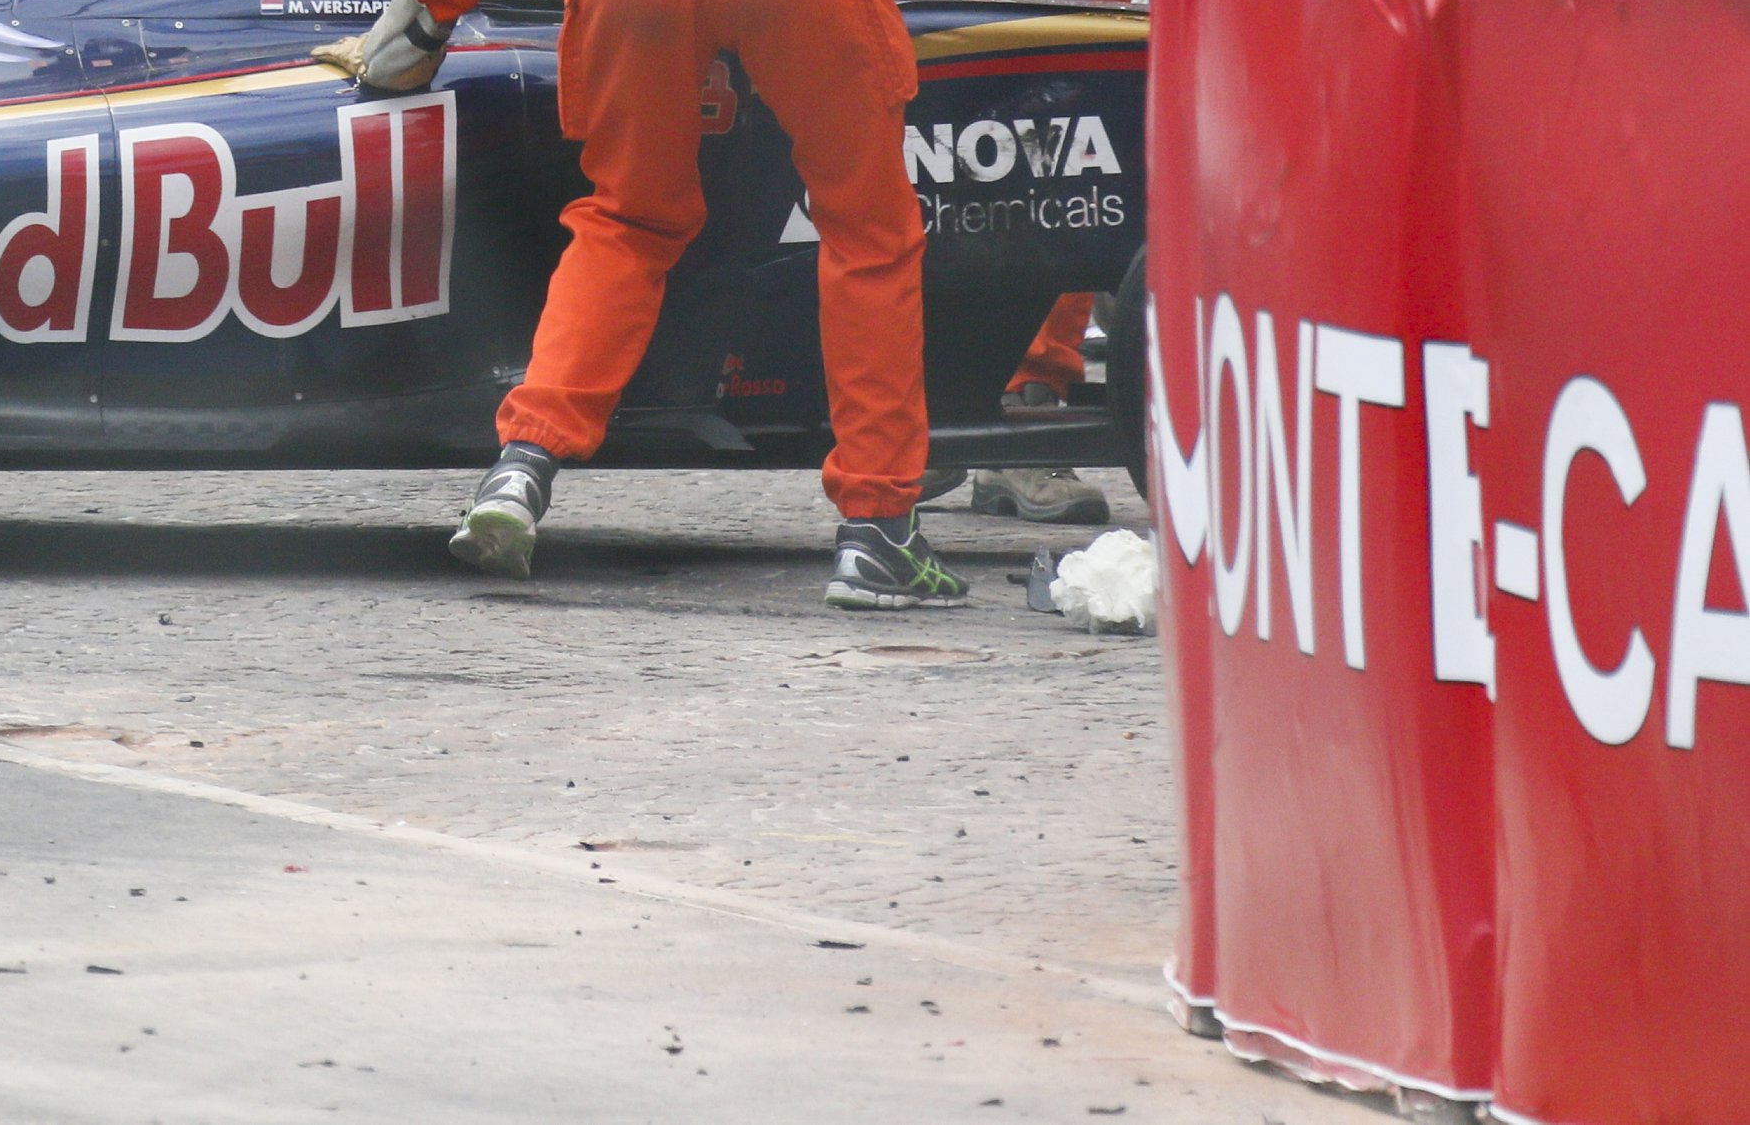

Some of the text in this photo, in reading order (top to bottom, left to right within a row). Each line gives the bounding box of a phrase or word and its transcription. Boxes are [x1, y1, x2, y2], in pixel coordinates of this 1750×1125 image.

[288, 0, 391, 14] M. VERSTAPP
[902, 116, 1123, 185] NOVA
[109, 90, 456, 342] Bull
